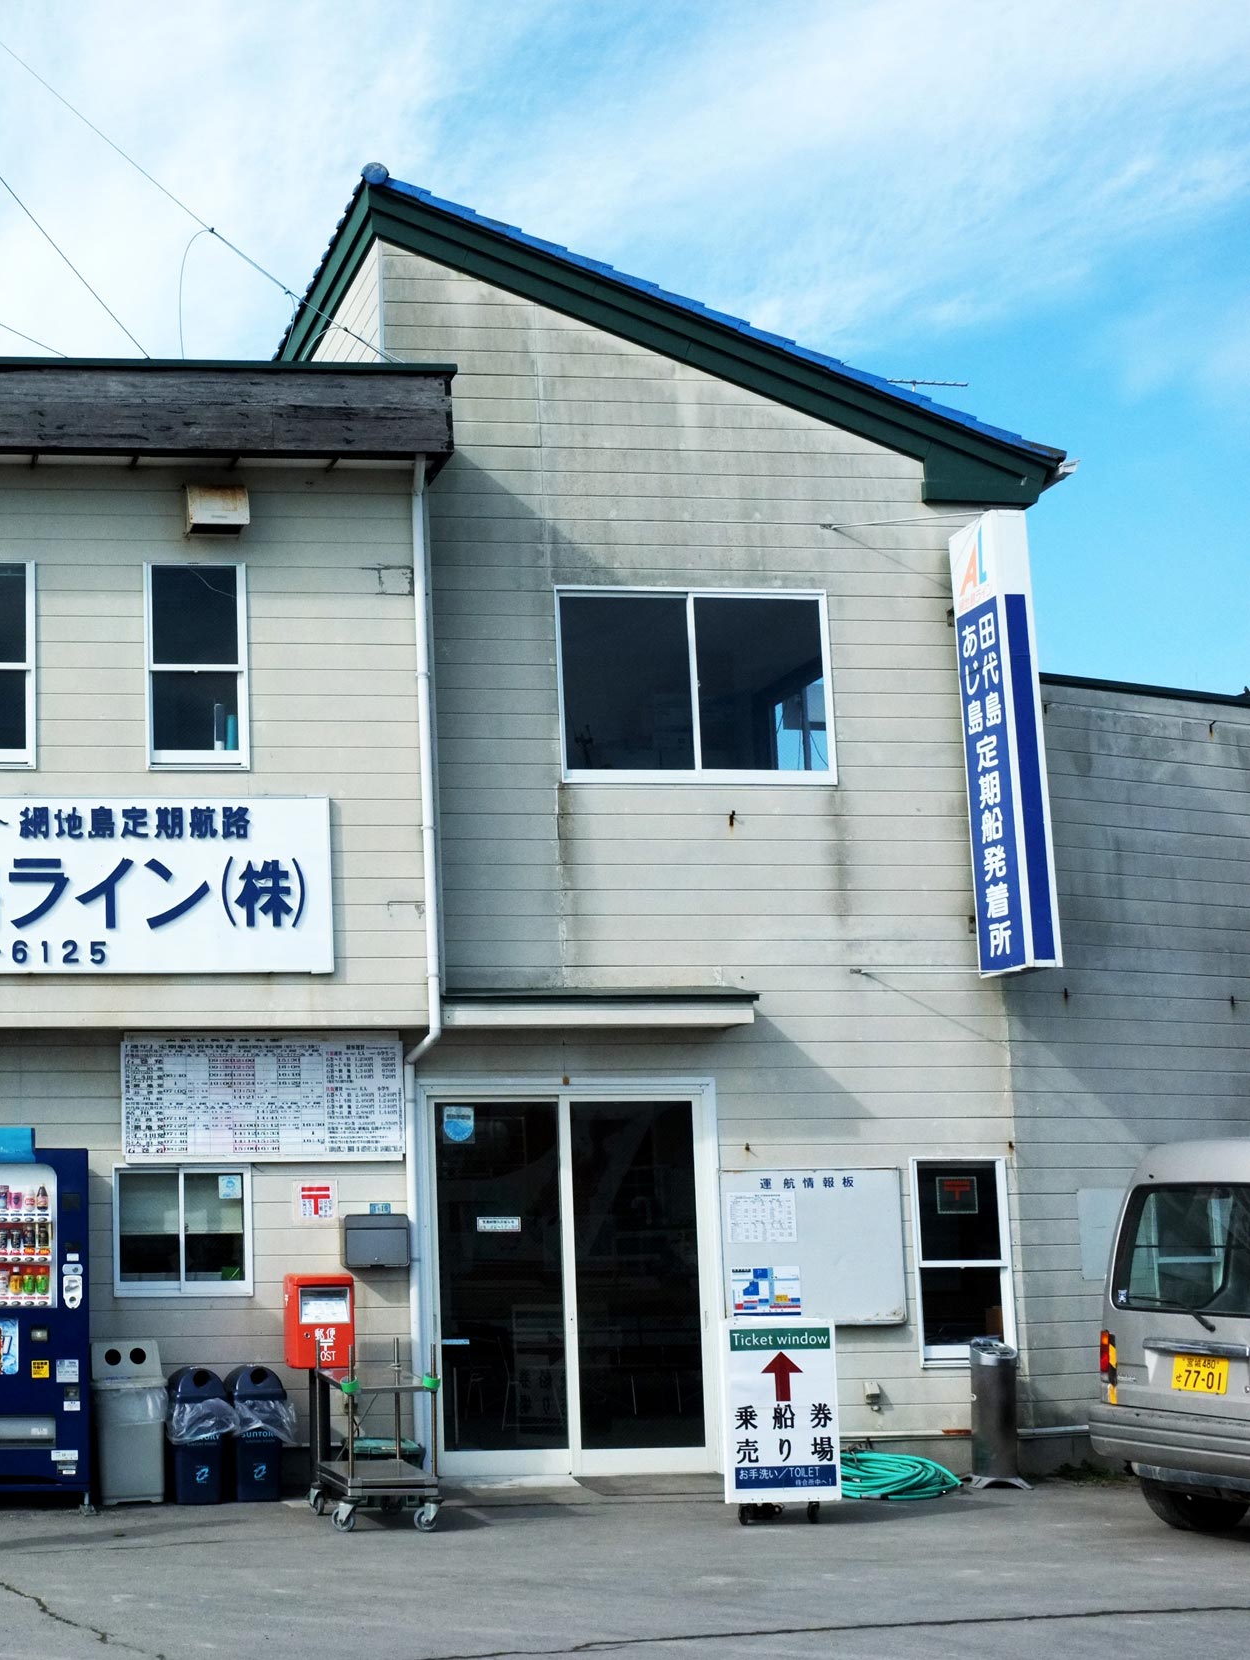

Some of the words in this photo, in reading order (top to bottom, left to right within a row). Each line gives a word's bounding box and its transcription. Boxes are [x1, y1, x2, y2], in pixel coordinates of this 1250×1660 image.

[961, 625, 984, 737] あじ島
[978, 611, 1003, 726] 田代島
[975, 733, 1012, 958] 定期船発着所
[759, 1176, 855, 1190] 運航情報板
[315, 1328, 336, 1340] 郵便
[732, 1332, 773, 1347] Ticket
[777, 1331, 829, 1345] window
[318, 1350, 336, 1361] OST
[1184, 1369, 1222, 1391] 77-01
[734, 1402, 833, 1431] 乗船券
[735, 1436, 835, 1465] 売り場
